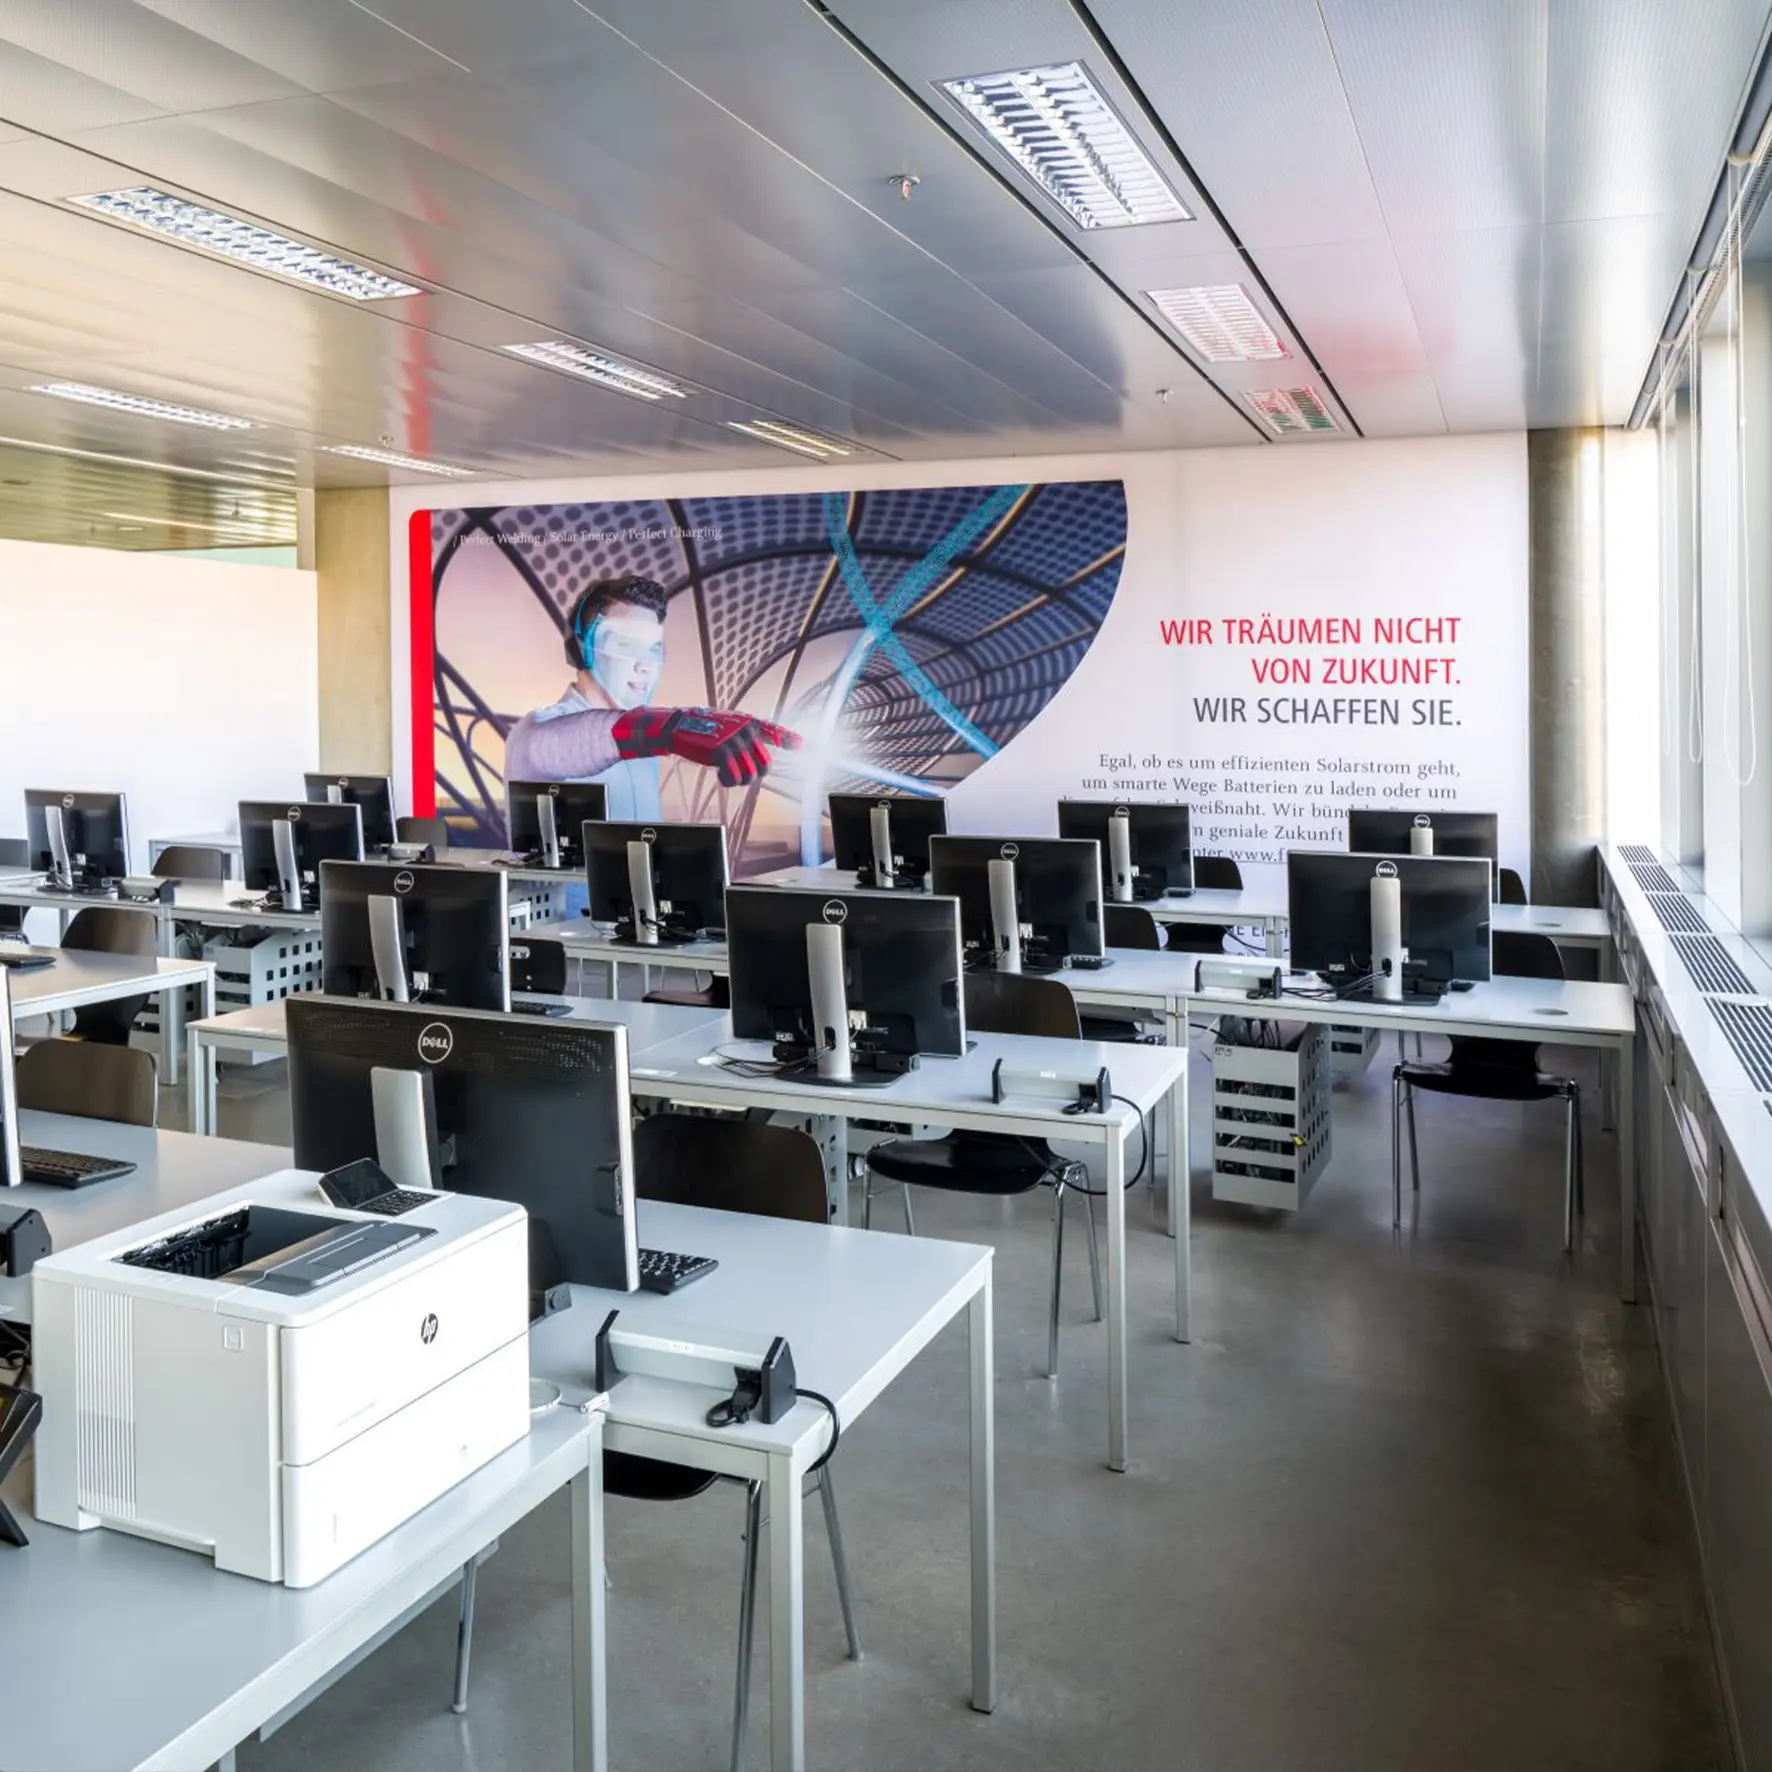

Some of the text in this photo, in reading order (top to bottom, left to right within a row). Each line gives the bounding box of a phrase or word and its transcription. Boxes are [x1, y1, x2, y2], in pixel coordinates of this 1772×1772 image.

[497, 530, 541, 545] Welding
[550, 530, 576, 542] Solar
[581, 529, 619, 545] Energy
[628, 527, 667, 540] Perfect
[670, 525, 722, 541] Charging
[1160, 612, 1462, 646] WIR TRÄUMEN NICHT
[1251, 657, 1461, 685] VON ZUKUNFT.
[1193, 697, 1462, 726] WIR SCHAFFEN SIE.
[1100, 754, 1461, 780] Egal, ob es um effizienten Solarstrom geht,
[1082, 777, 1457, 799] um smarte Wege Batterien zu laden oder um
[1272, 802, 1305, 818] Wir
[1209, 823, 1268, 842] geniale
[1274, 825, 1343, 843] Zukunft
